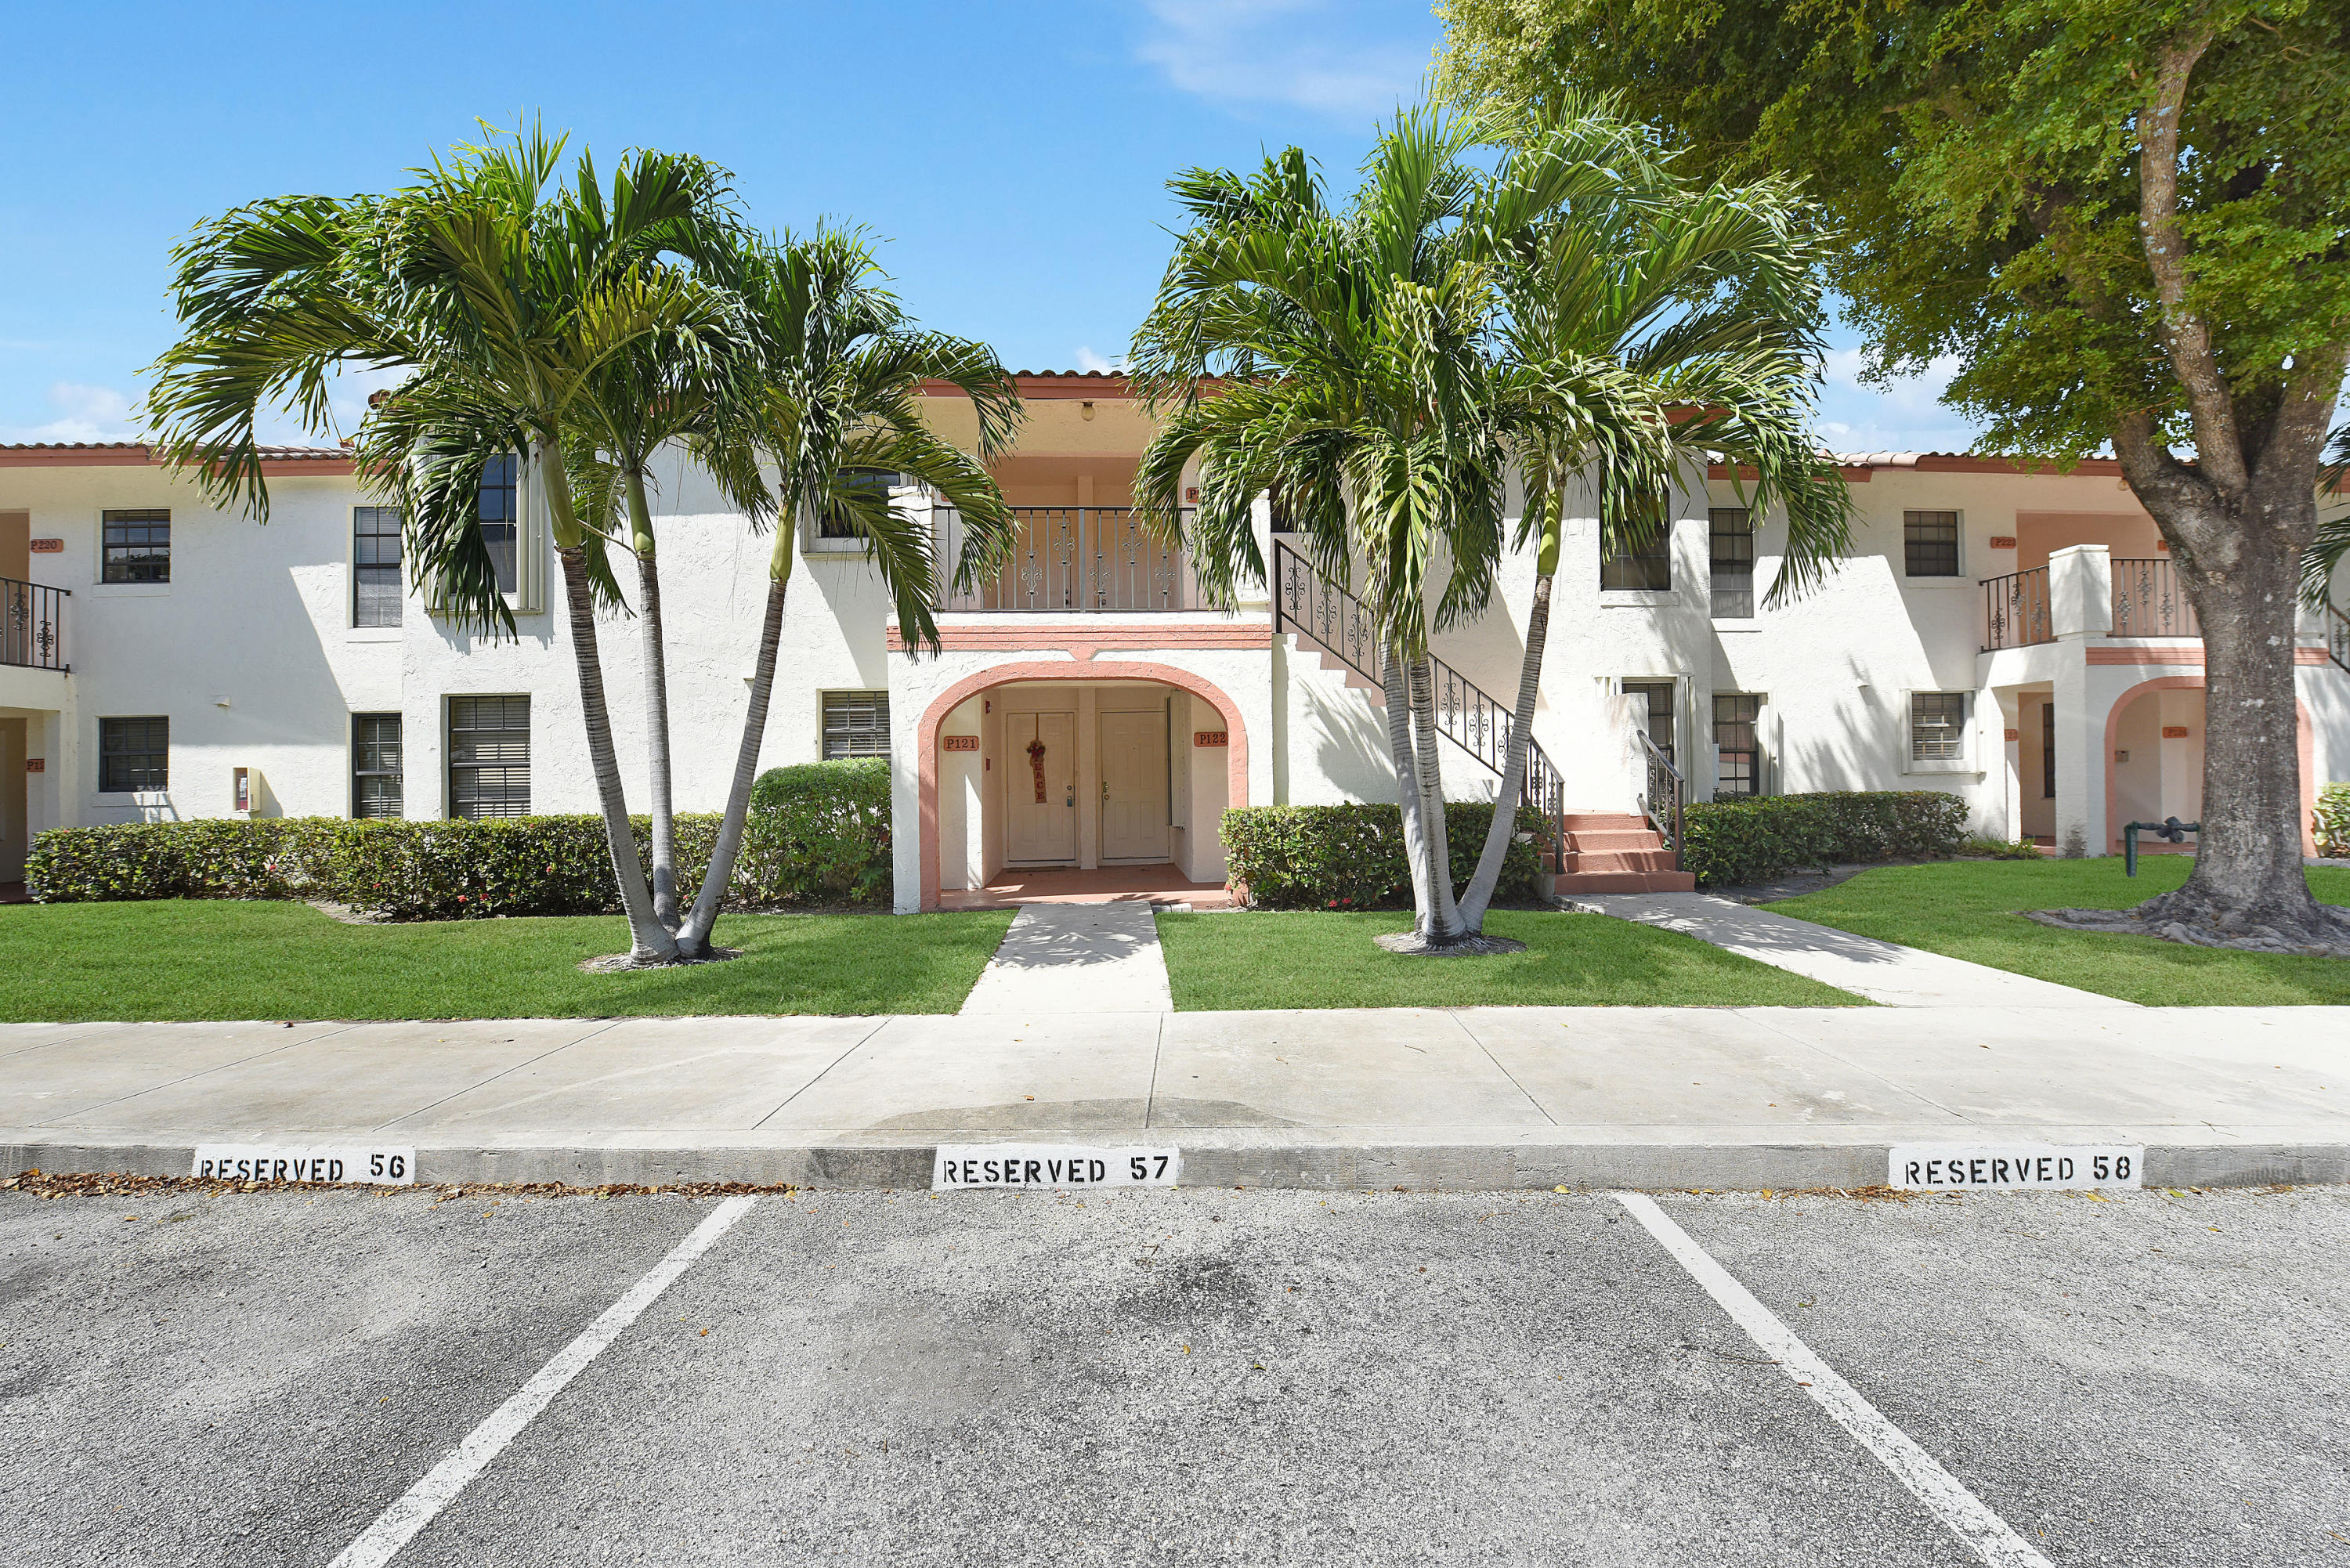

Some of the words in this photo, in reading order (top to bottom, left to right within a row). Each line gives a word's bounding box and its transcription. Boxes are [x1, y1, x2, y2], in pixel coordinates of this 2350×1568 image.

[31, 540, 57, 550] P220
[946, 739, 976, 749] P121
[1199, 733, 1226, 744] P122
[201, 1158, 343, 1182] RESERVED
[371, 1154, 405, 1179] 56
[943, 1159, 1105, 1183] RESERVED
[1130, 1155, 1169, 1180] 57
[1905, 1157, 2073, 1184] RESERVED
[2093, 1155, 2131, 1180] 58
